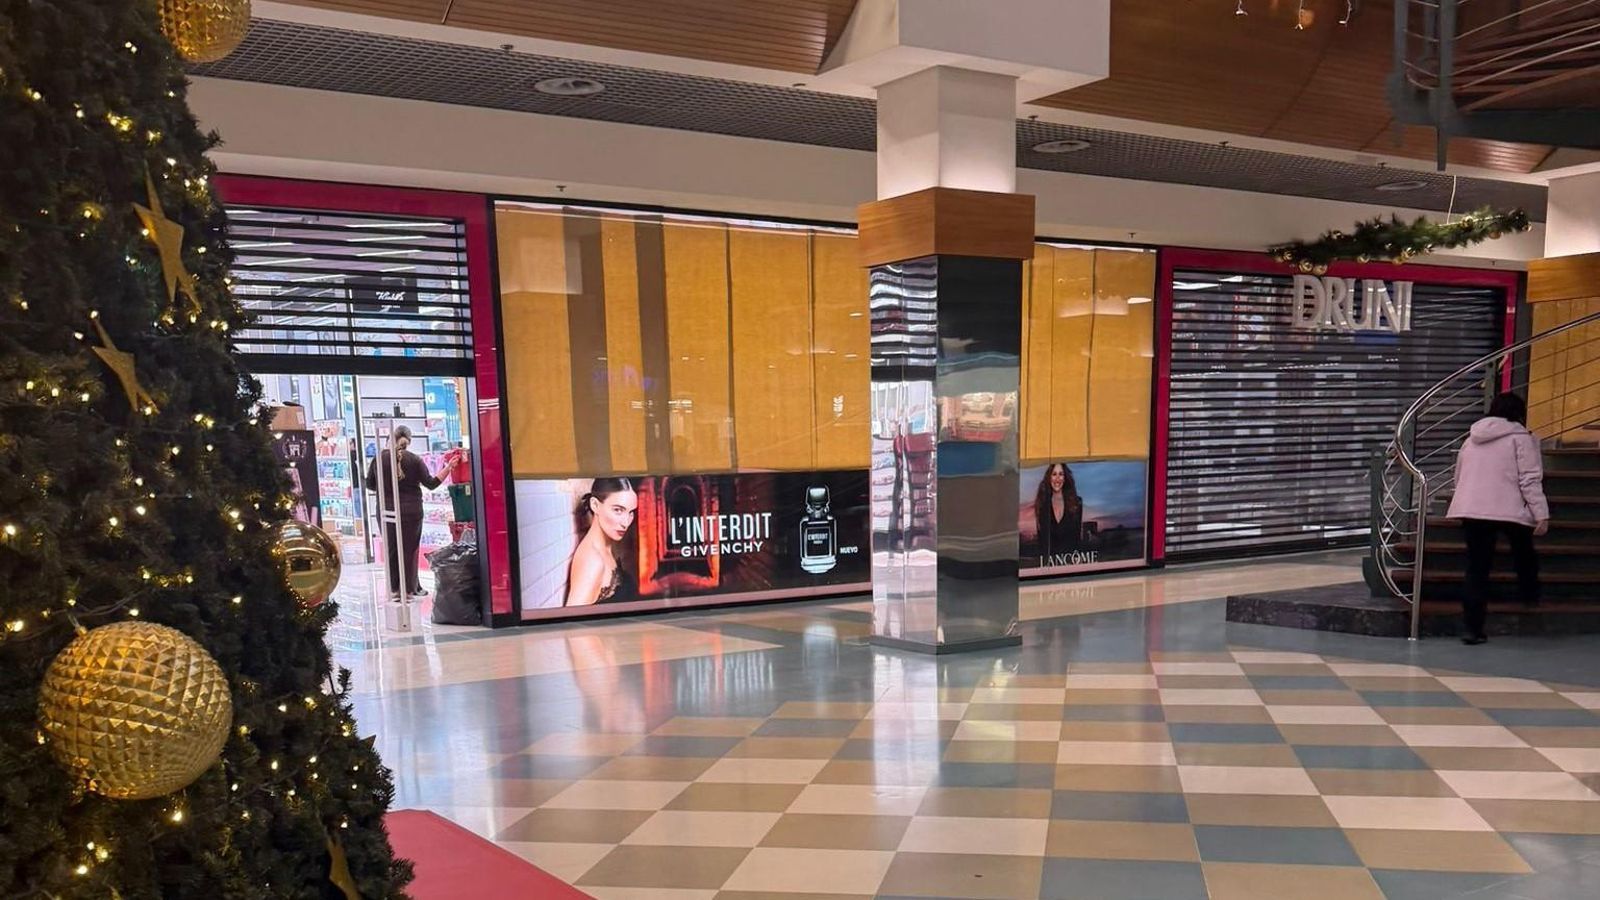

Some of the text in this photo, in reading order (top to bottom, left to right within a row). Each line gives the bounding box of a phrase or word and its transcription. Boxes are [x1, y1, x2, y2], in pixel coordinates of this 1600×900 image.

[1293, 275, 1414, 333] DRUNI
[671, 512, 772, 544] L'INTERDIT
[681, 541, 764, 557] GIVENCHY
[840, 546, 858, 554] NUEVO
[1040, 549, 1099, 568] LANCÔME
